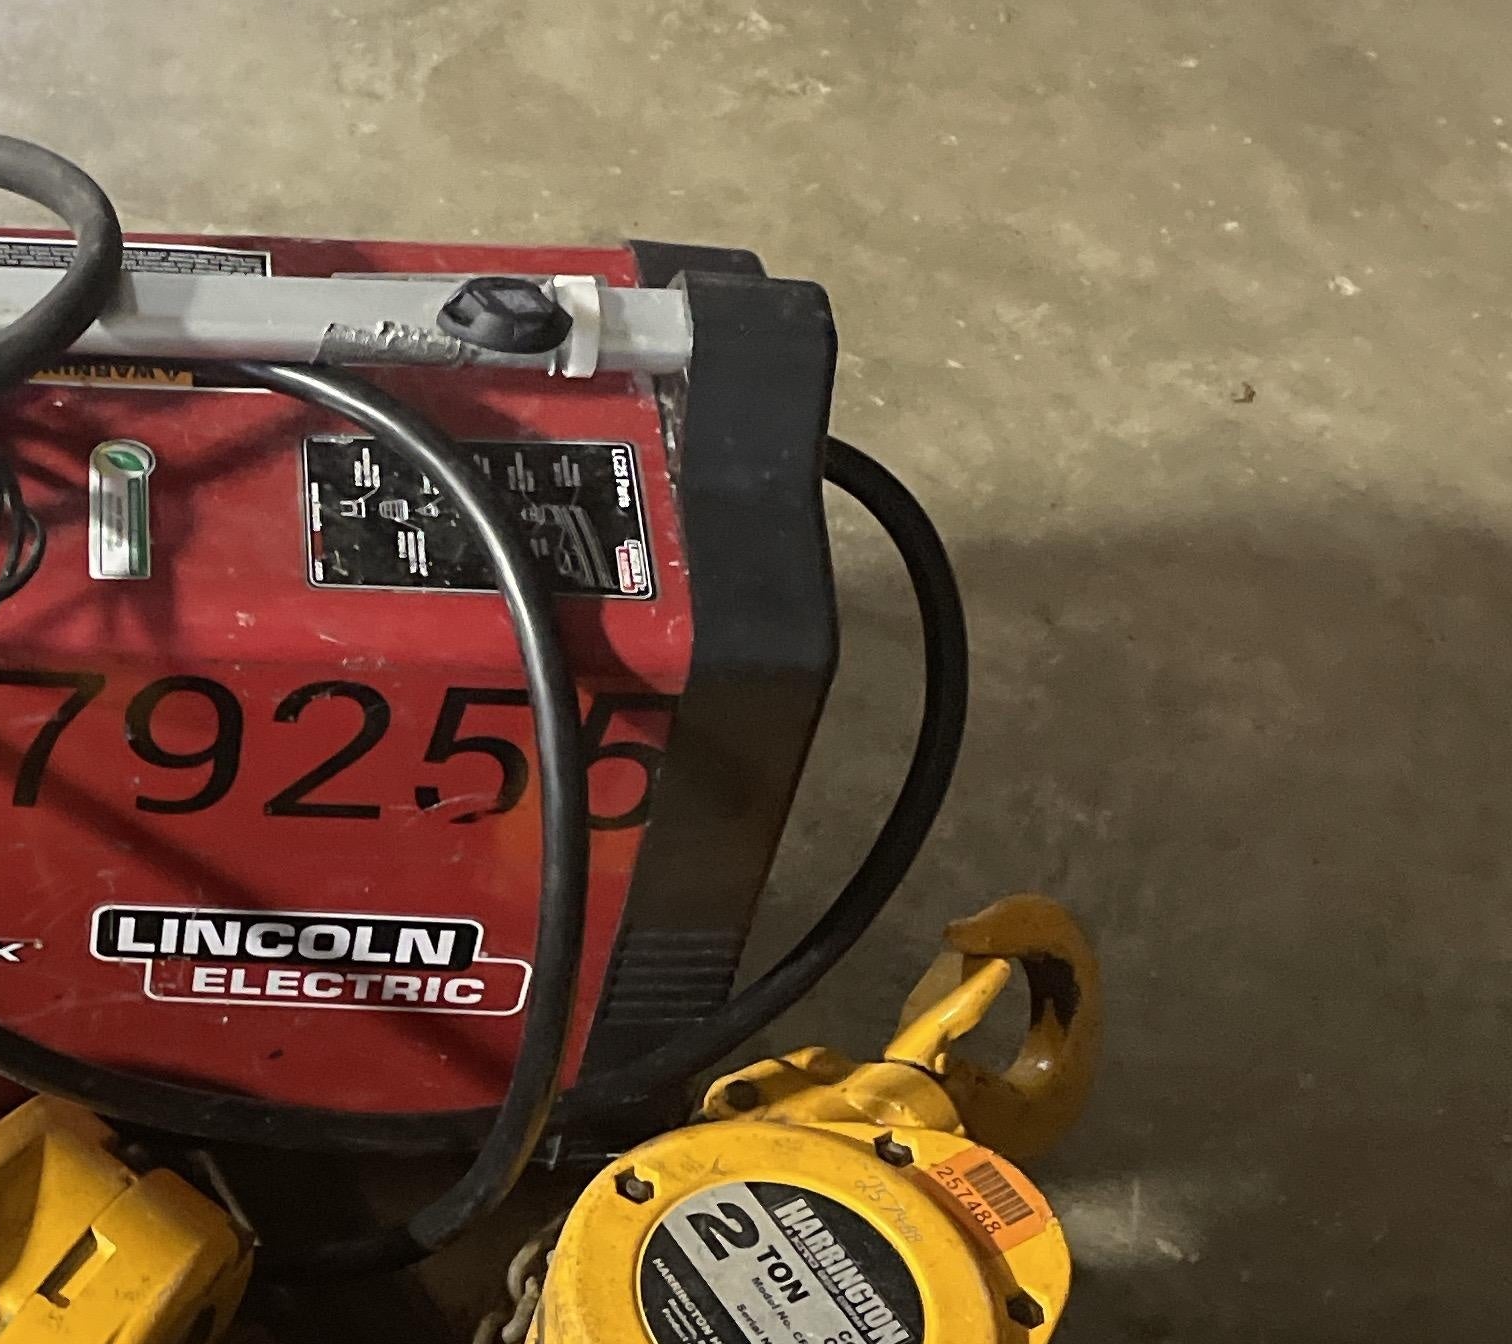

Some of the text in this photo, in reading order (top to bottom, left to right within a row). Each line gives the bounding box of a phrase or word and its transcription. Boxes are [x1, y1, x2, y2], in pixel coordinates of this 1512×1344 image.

[115, 915, 457, 965] LINCOLN
[190, 965, 485, 1005] ELECTRIC
[935, 1166, 1002, 1234] 257488
[685, 1202, 760, 1261] 2
[652, 1257, 714, 1336] HARRINGTON
[751, 1276, 782, 1310] Model
[756, 1244, 811, 1304] TON
[736, 1303, 765, 1337] Serial
